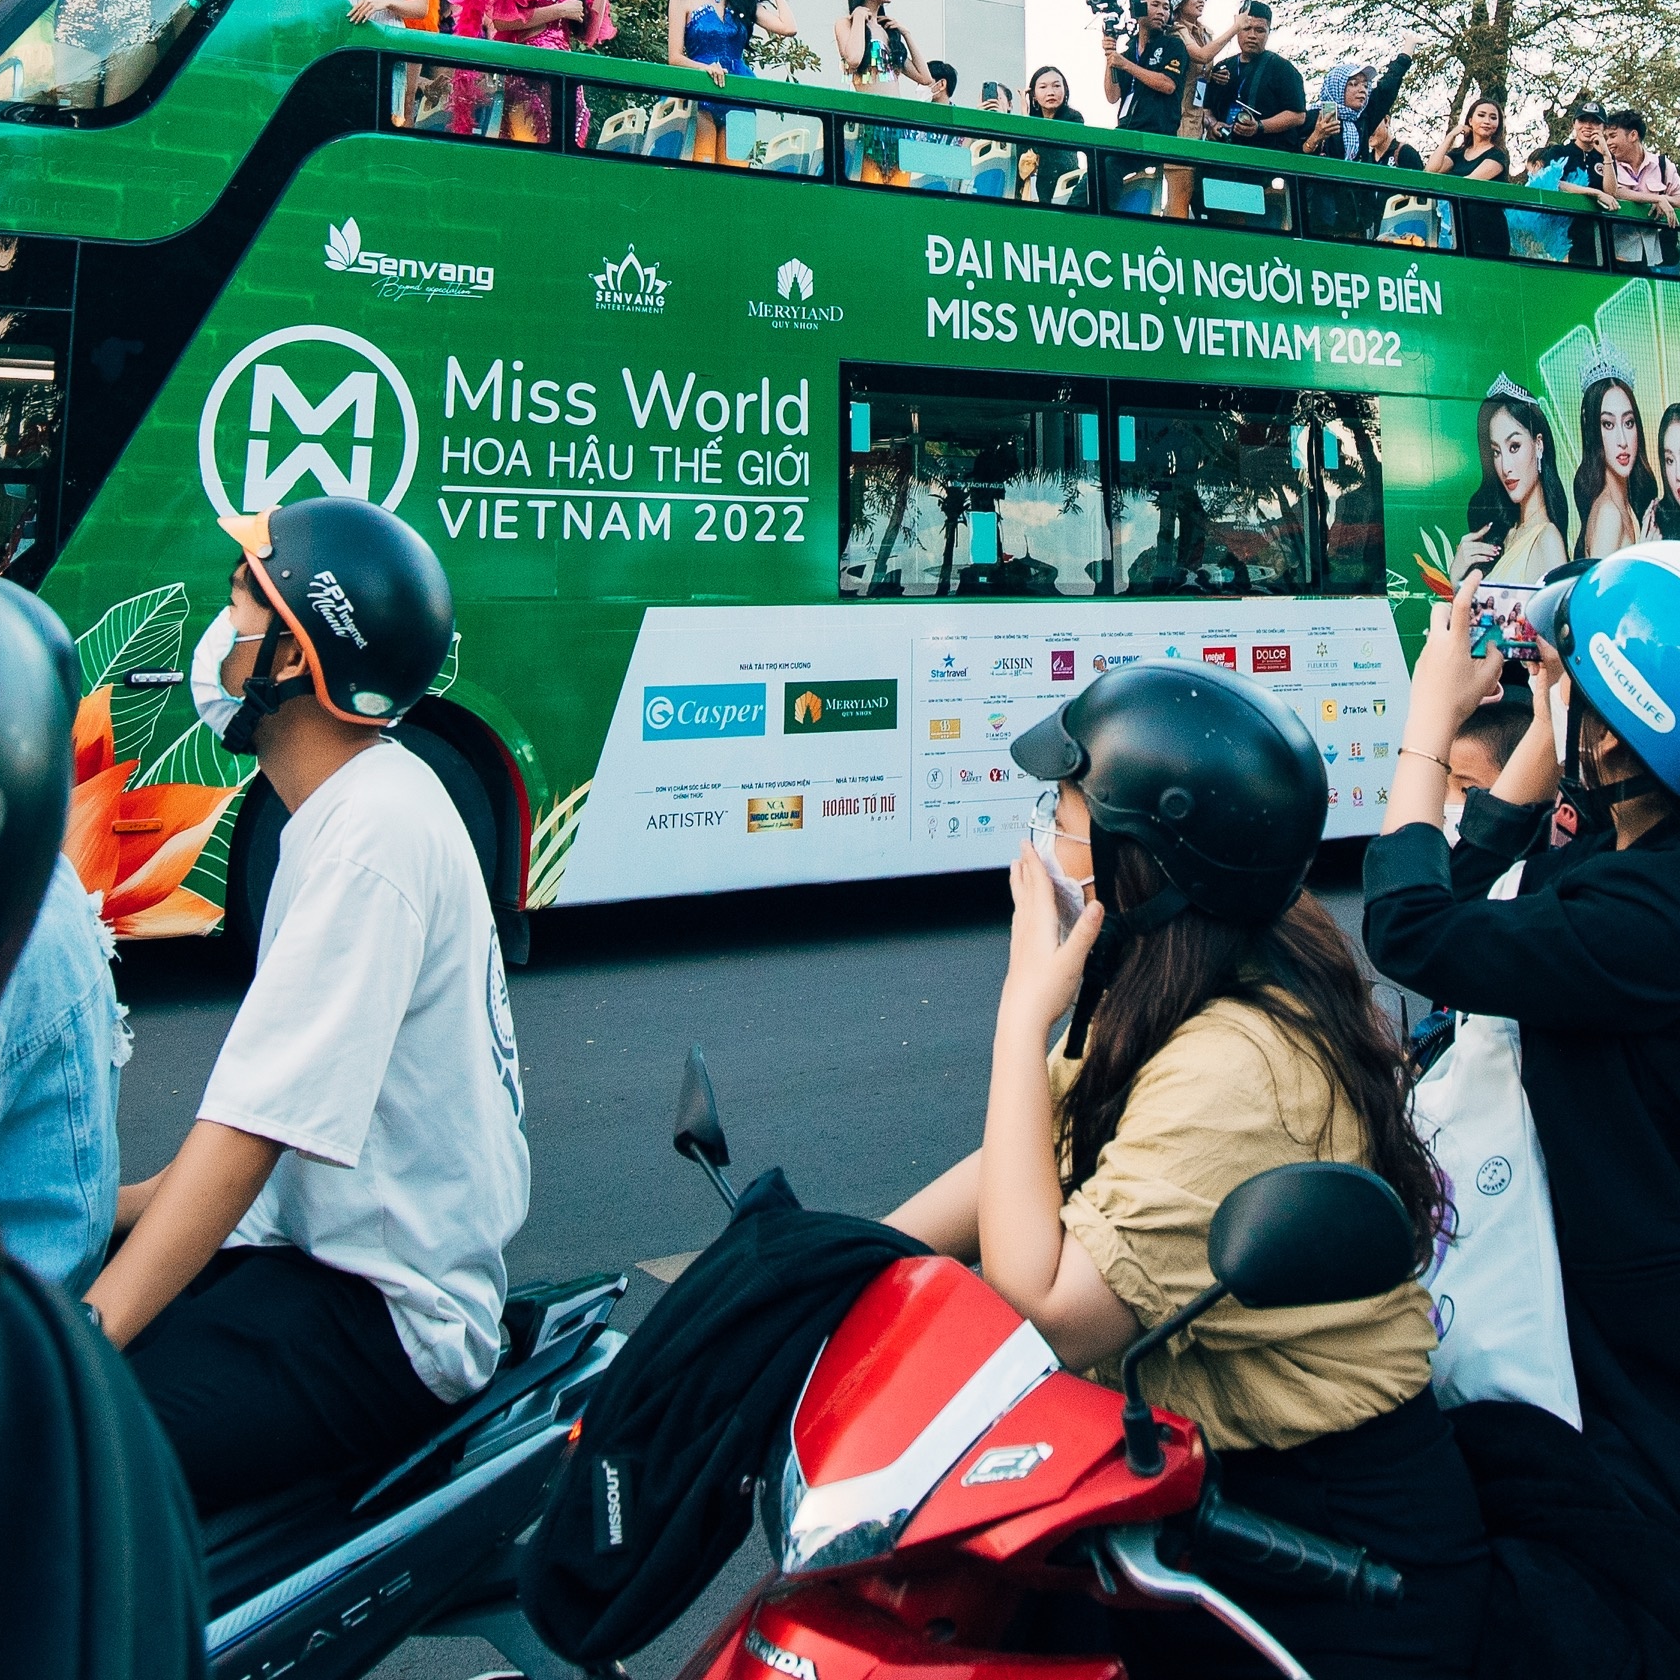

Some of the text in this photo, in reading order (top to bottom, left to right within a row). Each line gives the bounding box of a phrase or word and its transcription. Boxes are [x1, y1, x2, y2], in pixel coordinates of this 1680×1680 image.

[346, 251, 494, 291] Senvang
[925, 234, 1443, 320] ĐẠI NHẠC HỘI NGƯỜI ĐẸP BIỂN
[595, 290, 665, 307] SENVANG
[595, 303, 664, 314] ENTERTAINMENT
[748, 300, 844, 321] MERRYLAND
[771, 320, 819, 330] QUY NHƠN
[927, 296, 1402, 368] MISS WORLD VIETNAM 2022
[444, 354, 809, 437] Miss World
[442, 433, 810, 488] HOA HẬU THẾ GIỚI
[438, 498, 805, 543] VIETNAM 2022
[314, 571, 354, 614] FPT
[339, 610, 368, 650] Internet
[931, 668, 967, 678] Startravel
[1002, 657, 1033, 670] KISIN
[1596, 643, 1665, 723] DAI-ICHI LIFE
[677, 700, 763, 731] Casper
[826, 696, 889, 711] MERRYLAND
[1349, 706, 1367, 714] TikTok
[646, 811, 725, 830] ARTISTRY
[606, 1467, 624, 1545] MISSOUT
